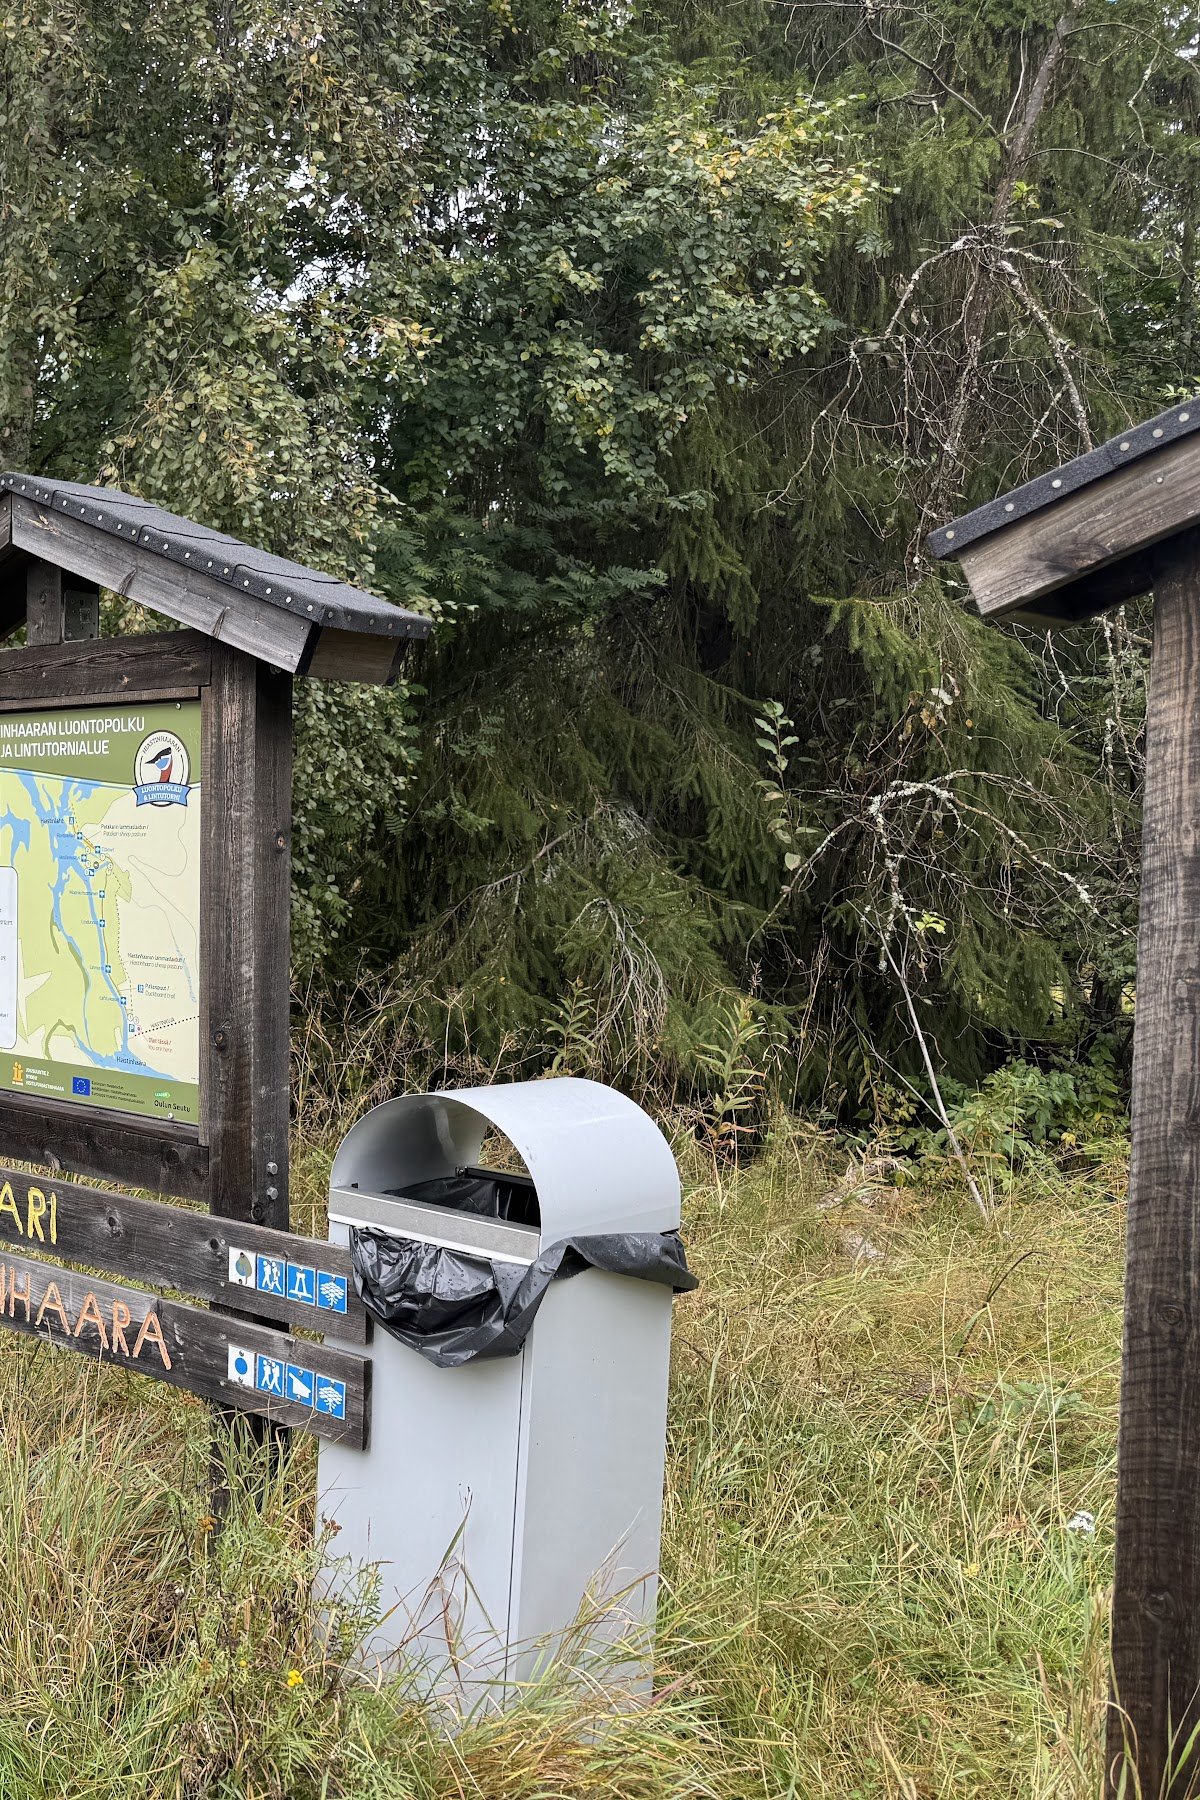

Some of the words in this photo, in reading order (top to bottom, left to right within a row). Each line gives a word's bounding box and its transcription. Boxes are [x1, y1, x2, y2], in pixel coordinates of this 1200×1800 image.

[59, 716, 145, 736] LUONTOPOLKU
[0, 744, 13, 758] JA
[14, 739, 110, 758] LINTUTORNIALUE
